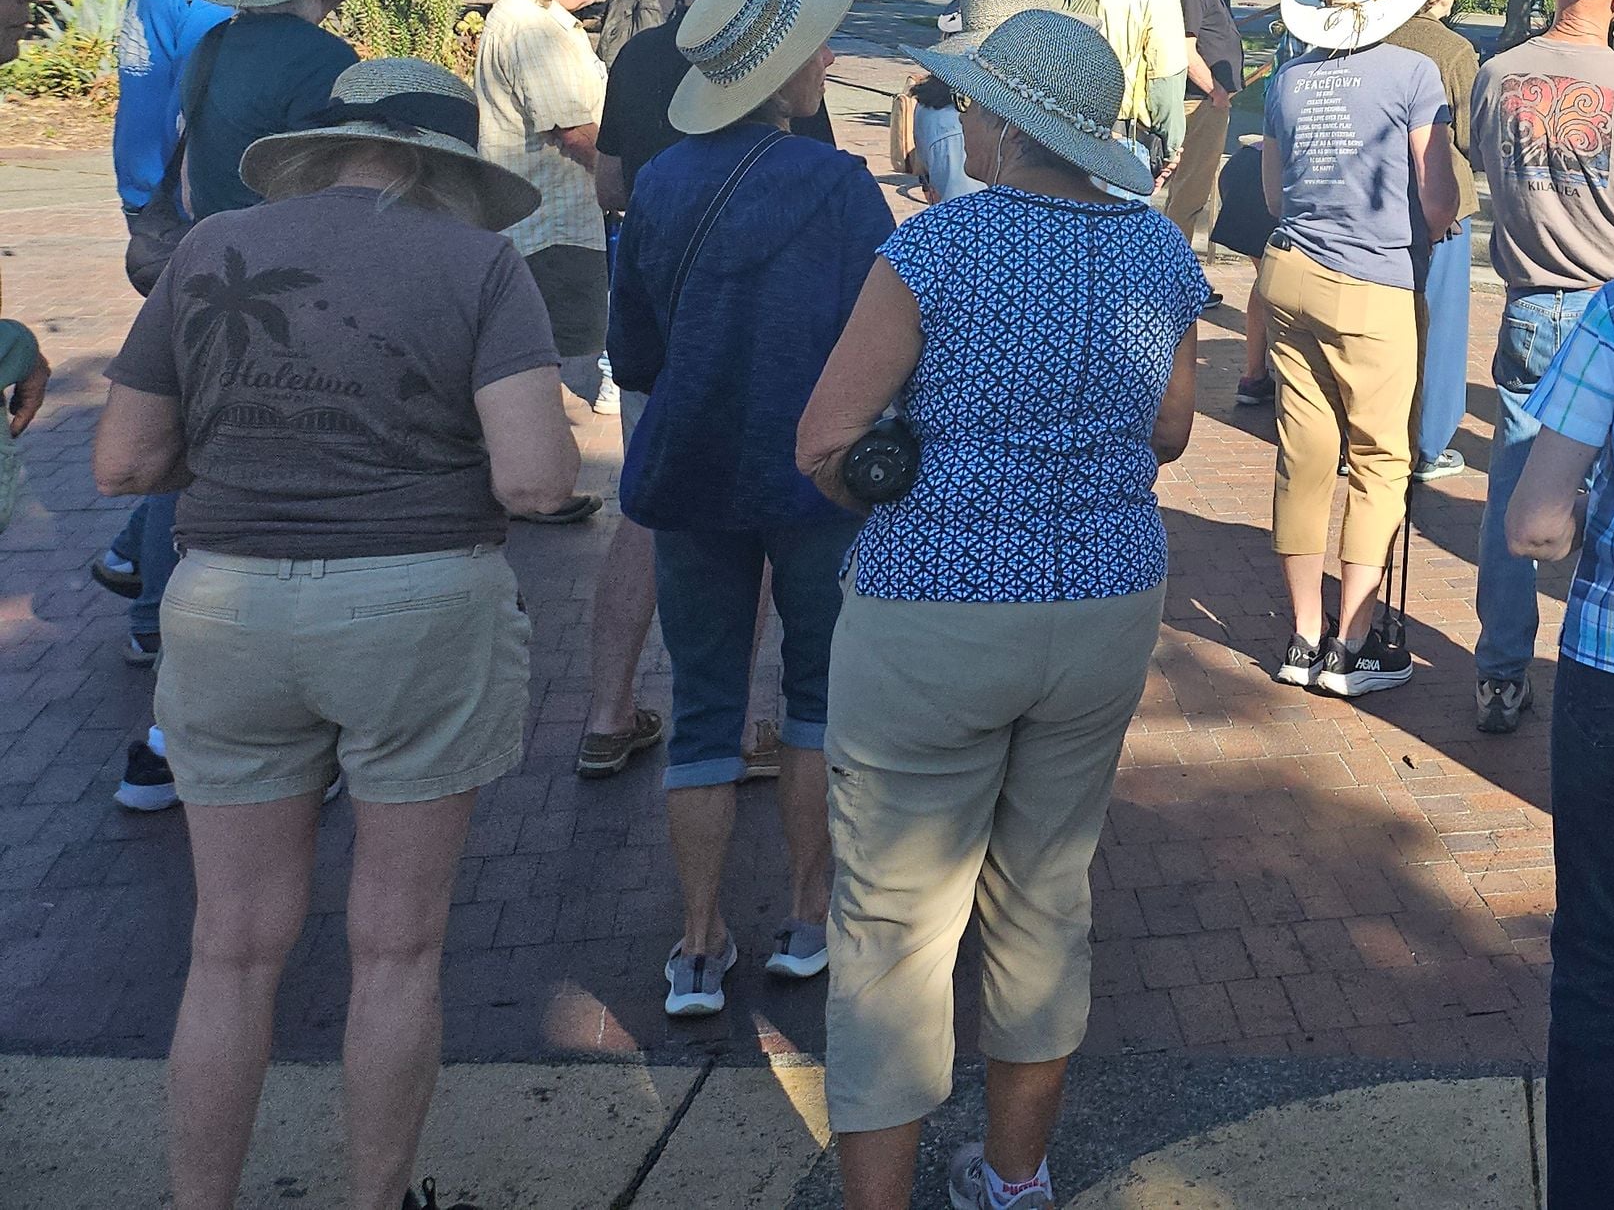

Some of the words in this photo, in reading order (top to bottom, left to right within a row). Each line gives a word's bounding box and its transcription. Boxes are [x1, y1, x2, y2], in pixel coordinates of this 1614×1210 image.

[1527, 180, 1581, 198] KILAUEA
[219, 358, 367, 397] Haleiwa
[1355, 657, 1380, 671] HOKA
